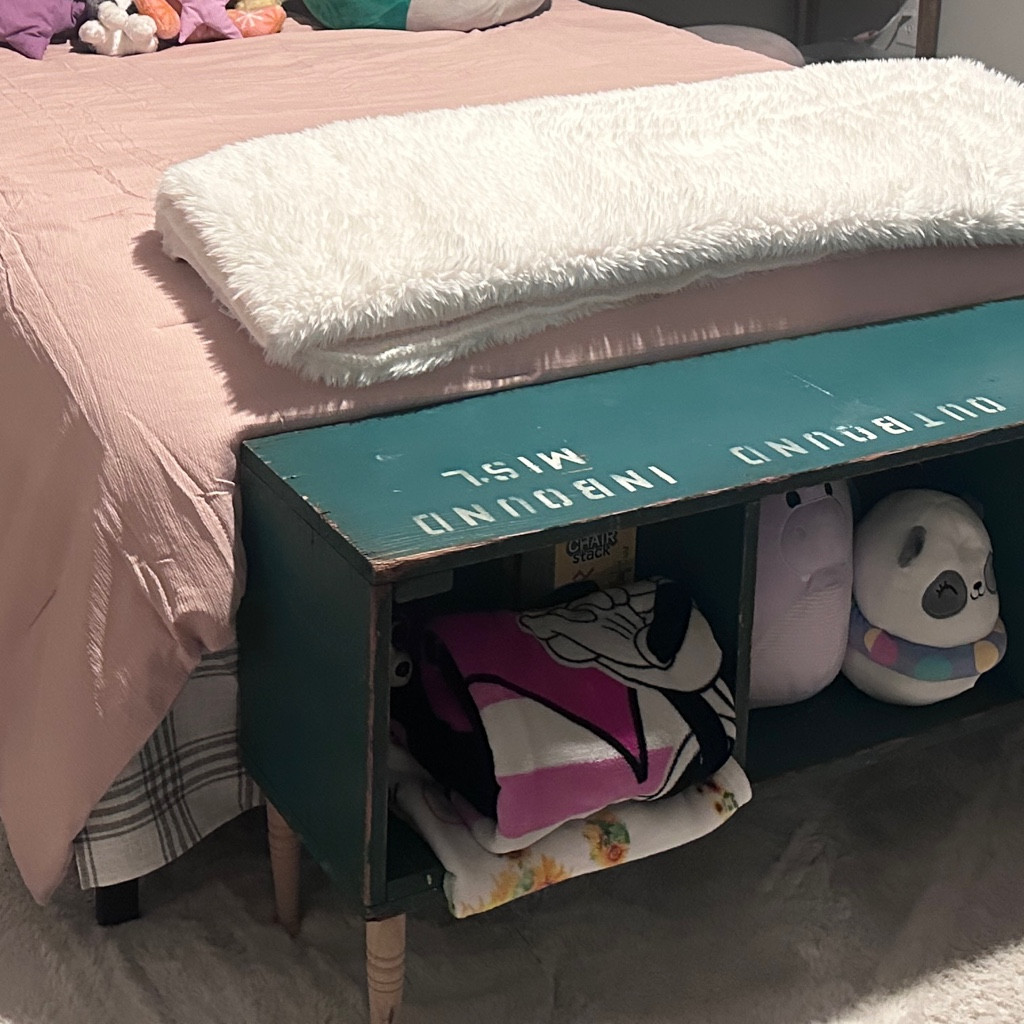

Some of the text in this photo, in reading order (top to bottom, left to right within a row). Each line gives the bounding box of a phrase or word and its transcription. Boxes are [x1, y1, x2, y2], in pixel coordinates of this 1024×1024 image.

[729, 396, 1007, 466] OUTBOUND
[412, 465, 678, 535] INBOUND
[566, 530, 618, 555] CHAIR
[572, 545, 611, 564] stack
